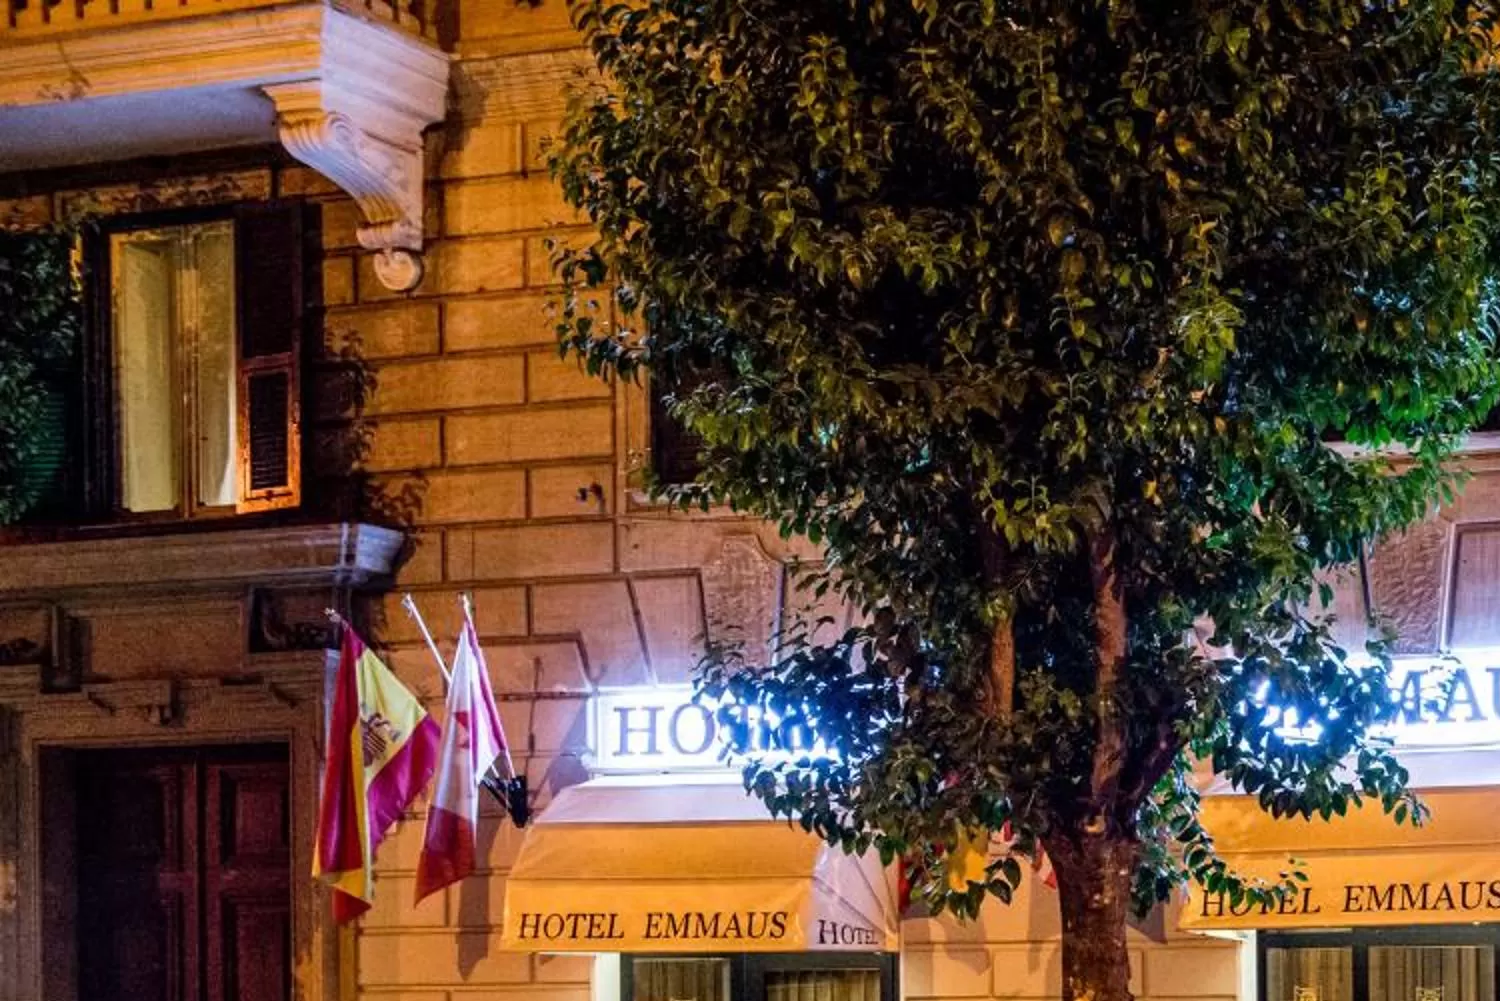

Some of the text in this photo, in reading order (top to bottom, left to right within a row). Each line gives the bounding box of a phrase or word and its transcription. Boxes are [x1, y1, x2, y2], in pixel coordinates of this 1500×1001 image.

[518, 911, 789, 939] HOTEL EMMAUS
[818, 919, 879, 945] HOTEL
